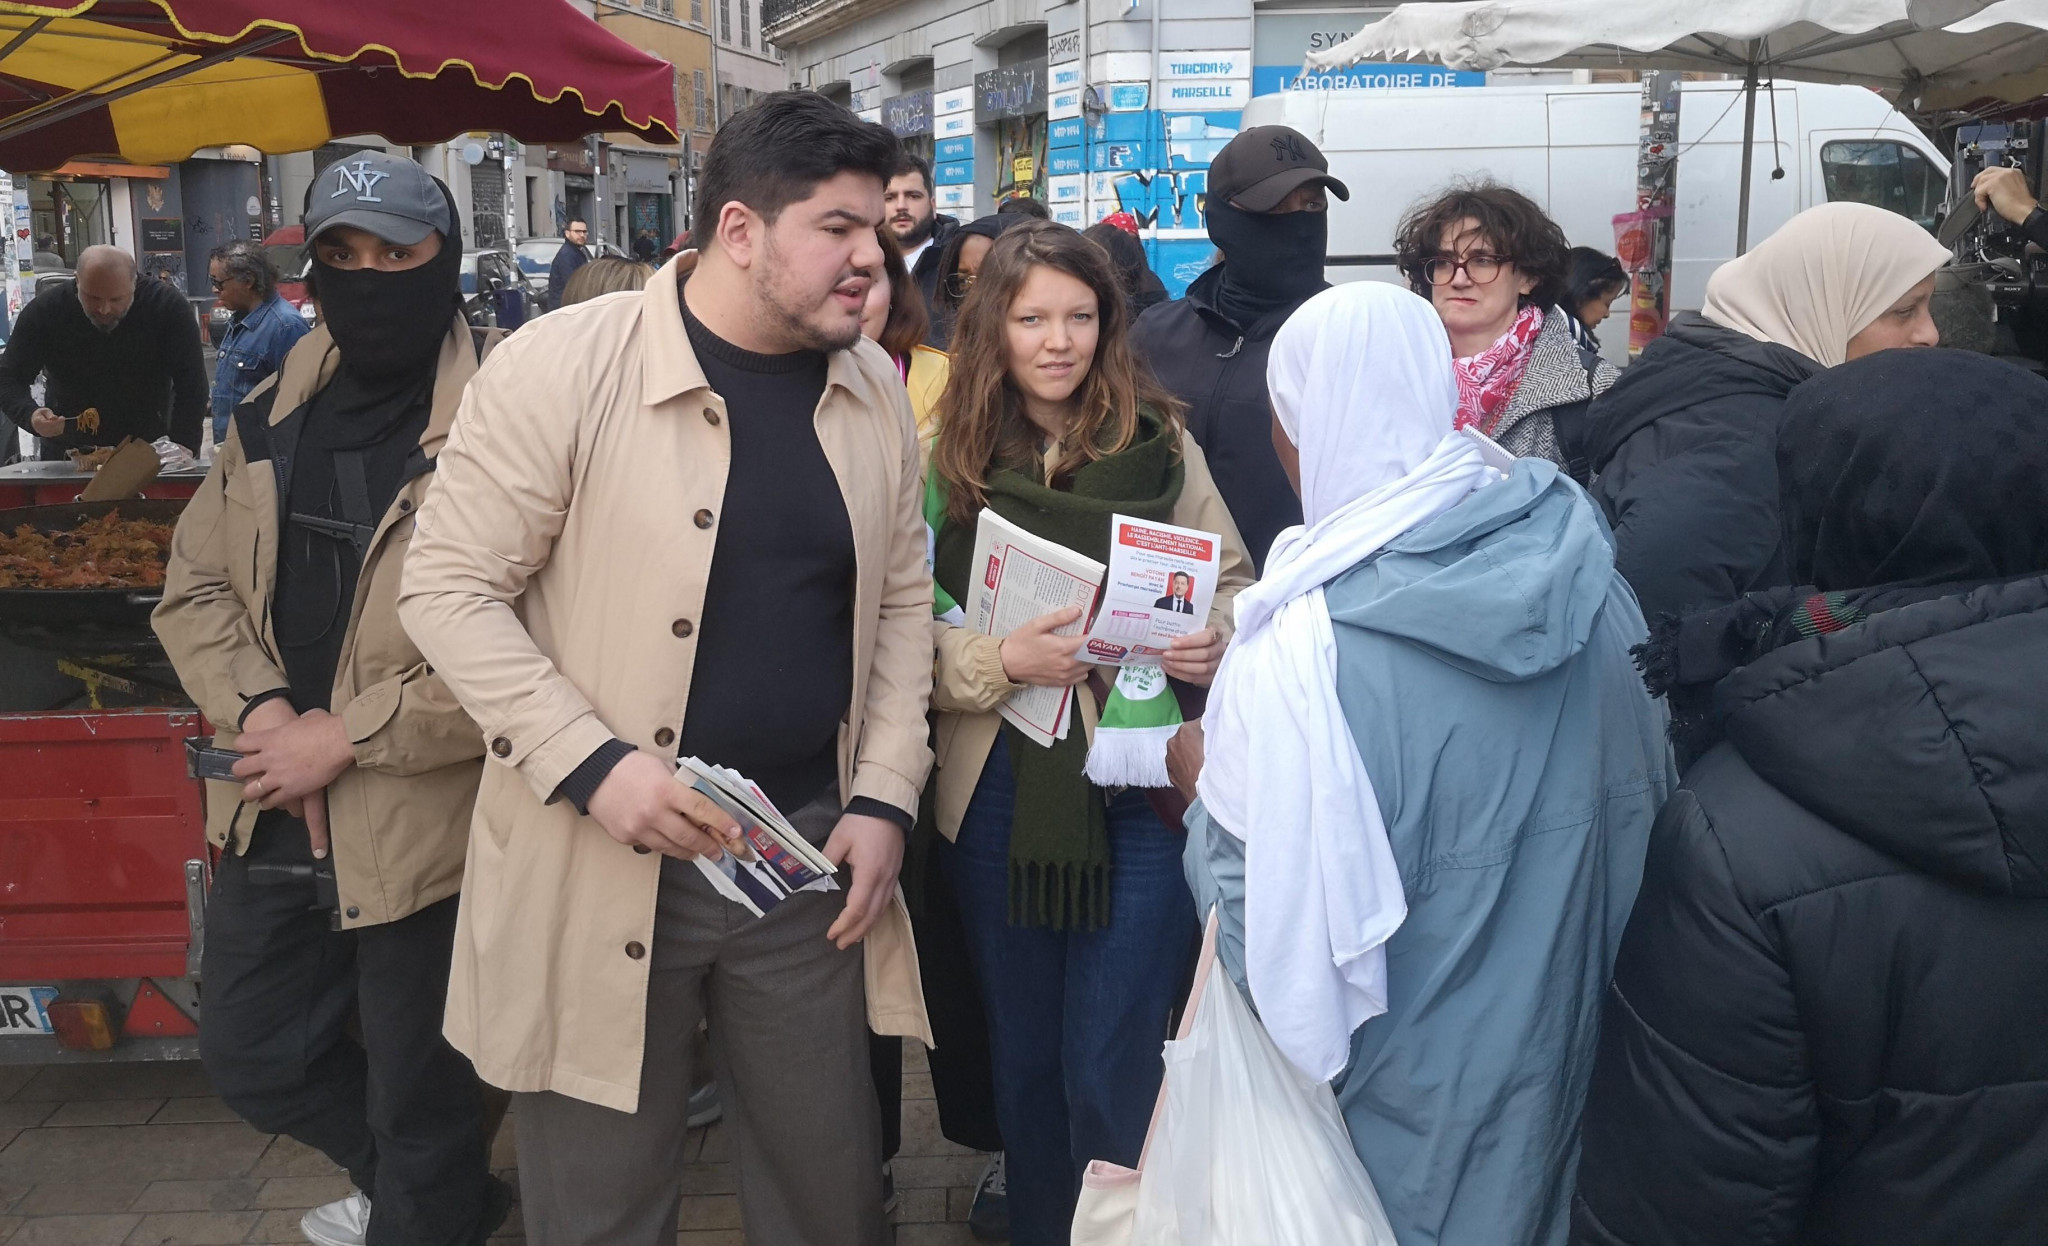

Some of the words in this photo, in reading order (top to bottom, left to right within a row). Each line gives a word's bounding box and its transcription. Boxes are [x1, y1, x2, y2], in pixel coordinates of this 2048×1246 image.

[1280, 74, 1422, 90] LABORATOIRE
[1429, 73, 1456, 88] DE
[1172, 86, 1232, 98] MARSEILLE
[331, 161, 390, 202] NY
[1134, 533, 1178, 546] RASSEMBLEMENT
[1090, 641, 1121, 652] PAYAN
